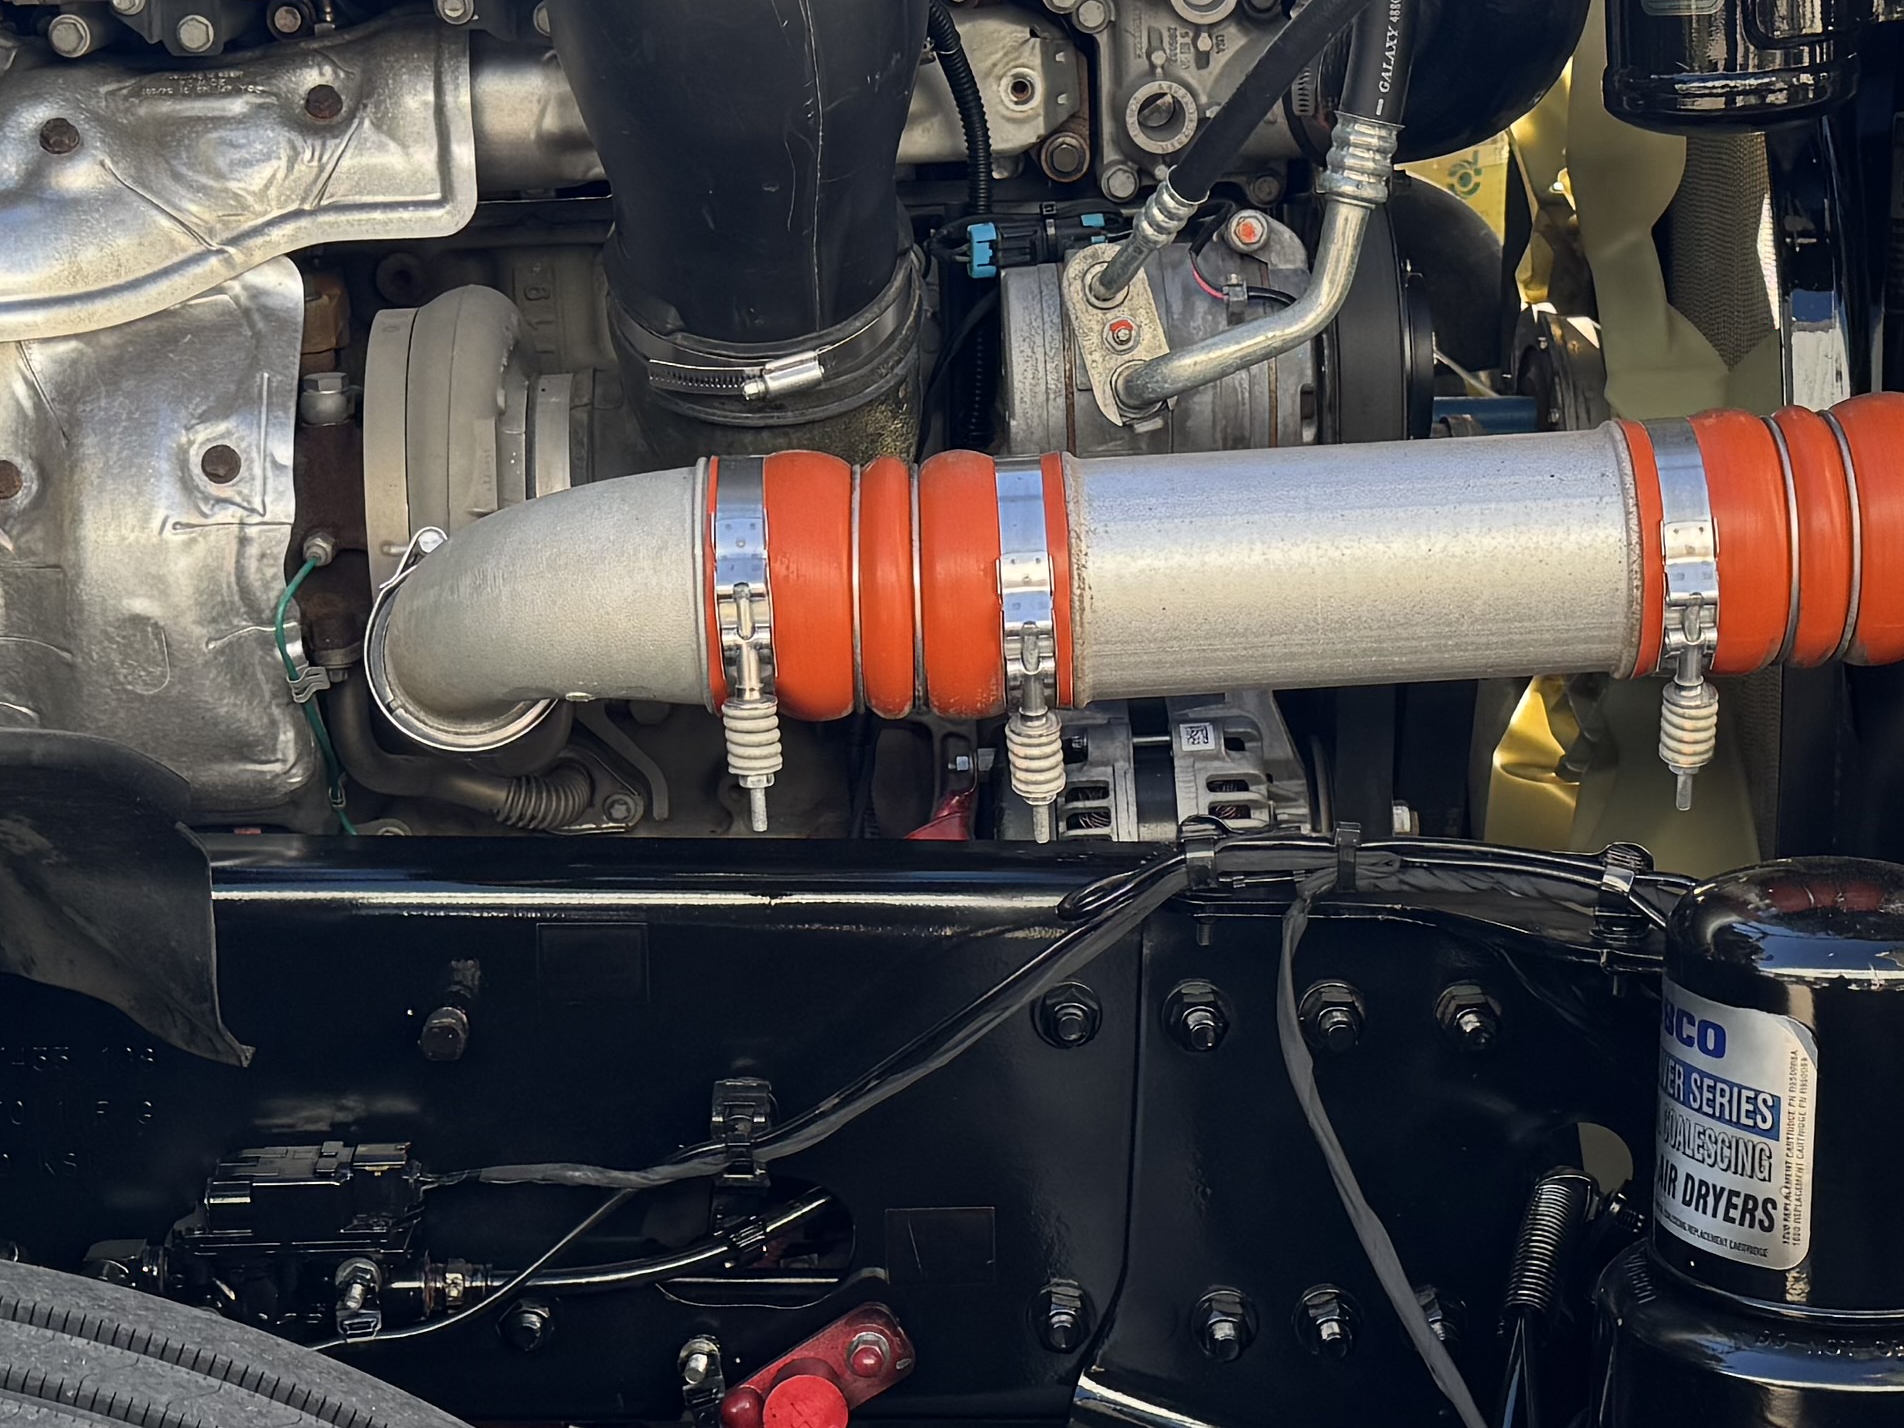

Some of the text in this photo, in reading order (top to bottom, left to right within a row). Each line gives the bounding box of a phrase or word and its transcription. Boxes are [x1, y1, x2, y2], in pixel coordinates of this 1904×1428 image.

[1379, 25, 1399, 94] GALAXY
[1689, 1074, 1775, 1132] SERIES
[1681, 1174, 1778, 1233] DRYERS
